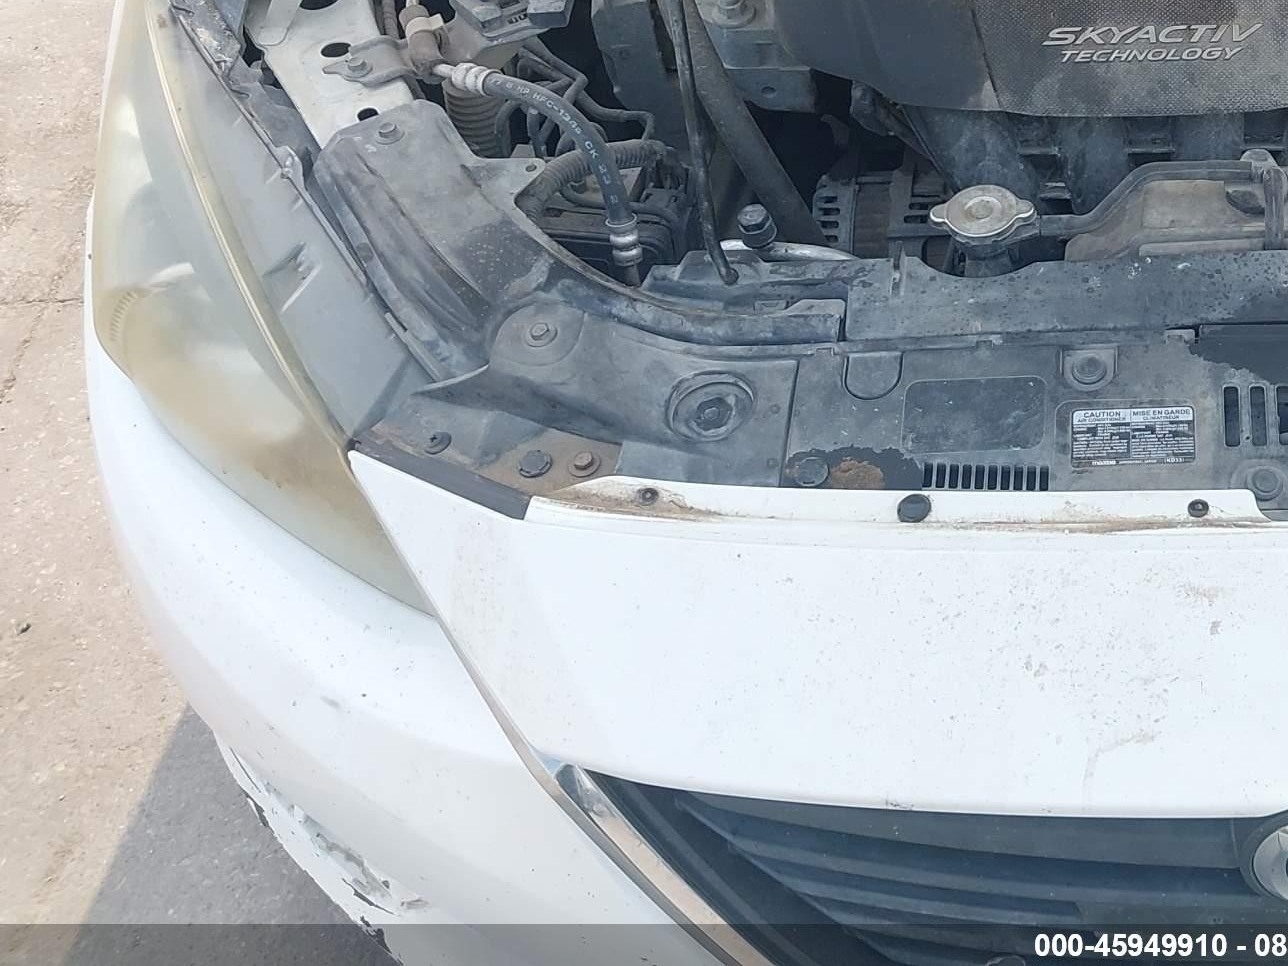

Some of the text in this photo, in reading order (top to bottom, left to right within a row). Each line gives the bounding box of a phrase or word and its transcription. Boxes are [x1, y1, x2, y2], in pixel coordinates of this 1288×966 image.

[1042, 23, 1263, 46] SKYACTIV
[1060, 46, 1243, 63] TECHNOLOGY
[584, 141, 599, 159] CK
[1164, 408, 1191, 416] GARDE
